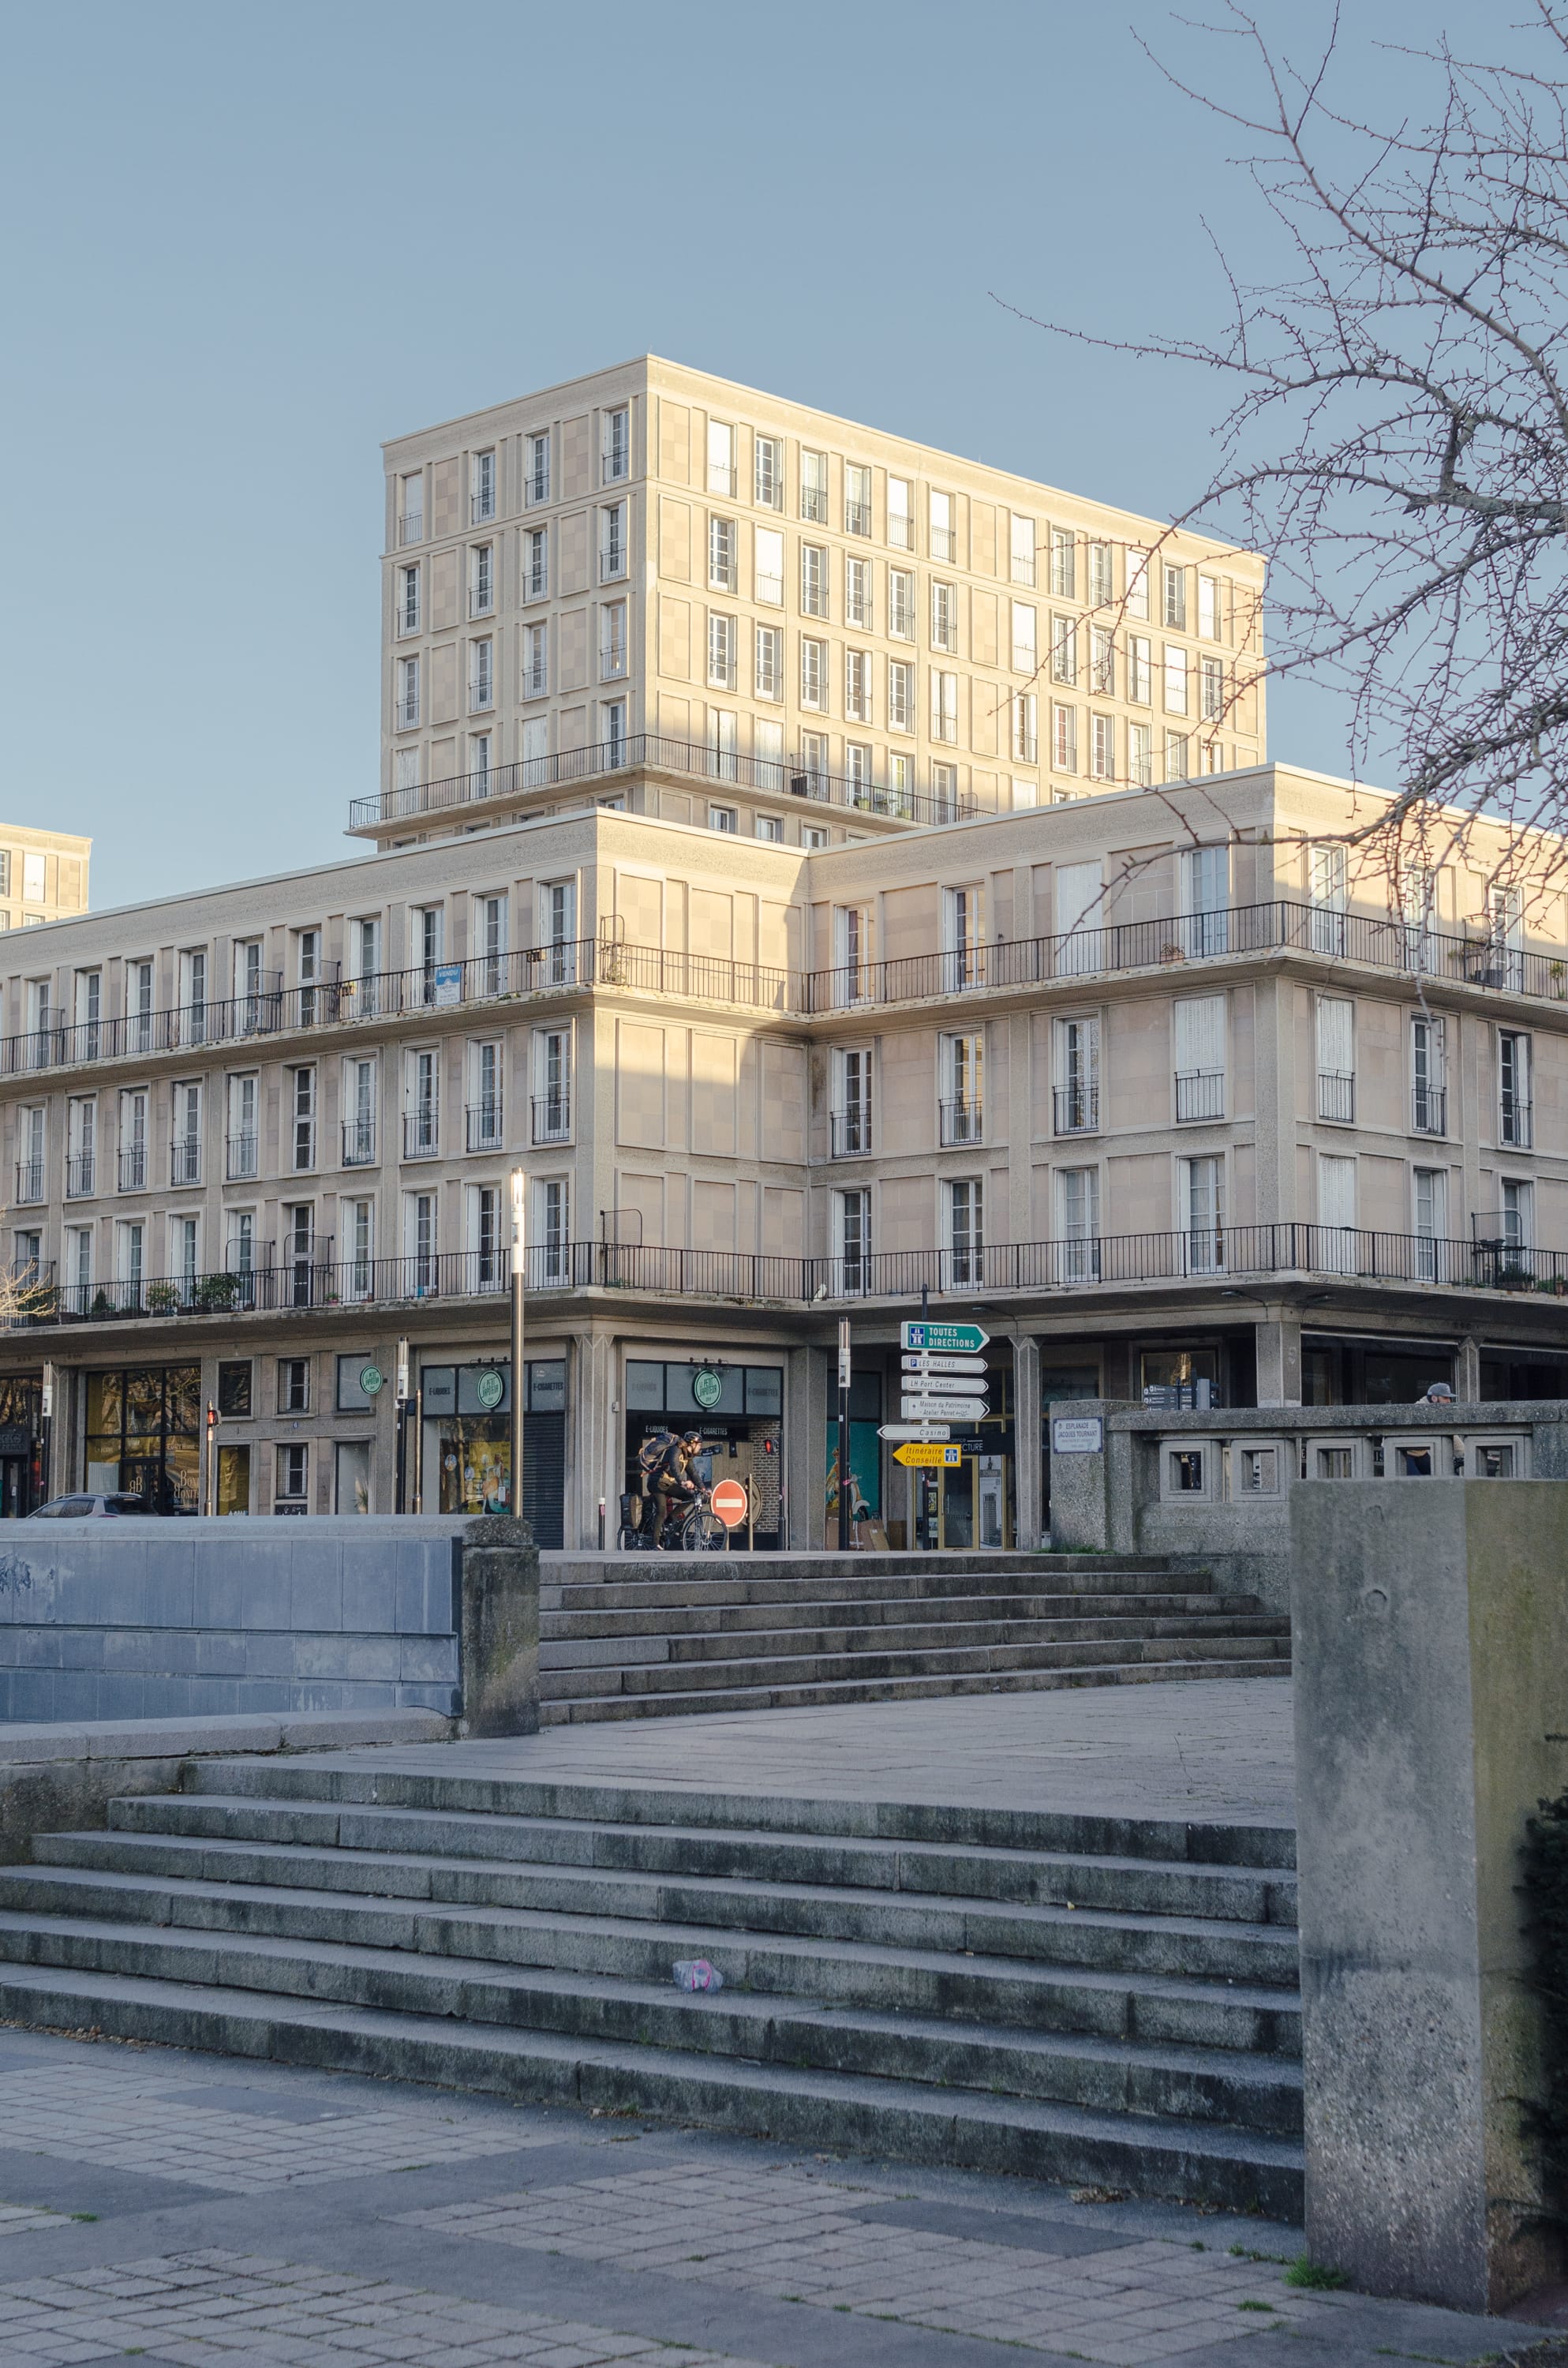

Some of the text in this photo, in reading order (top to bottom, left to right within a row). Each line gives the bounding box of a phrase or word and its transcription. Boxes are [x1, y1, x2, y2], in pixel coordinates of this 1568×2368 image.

[439, 969, 458, 978] VENDU
[929, 1327, 958, 1337] TOUTES
[929, 1337, 975, 1348] DIRECTIONS
[919, 1359, 931, 1368] LES
[533, 1382, 563, 1392] E-CIGARETTES
[935, 1381, 955, 1389] Center
[428, 1387, 451, 1396] E-LIQUIDES
[945, 1401, 971, 1410] Patrimoine
[645, 1425, 668, 1433] E-LIQUIDES
[699, 1427, 728, 1436] E-CIGARETTES
[905, 1446, 943, 1455] Itinéraire
[905, 1455, 942, 1464] Conseillé
